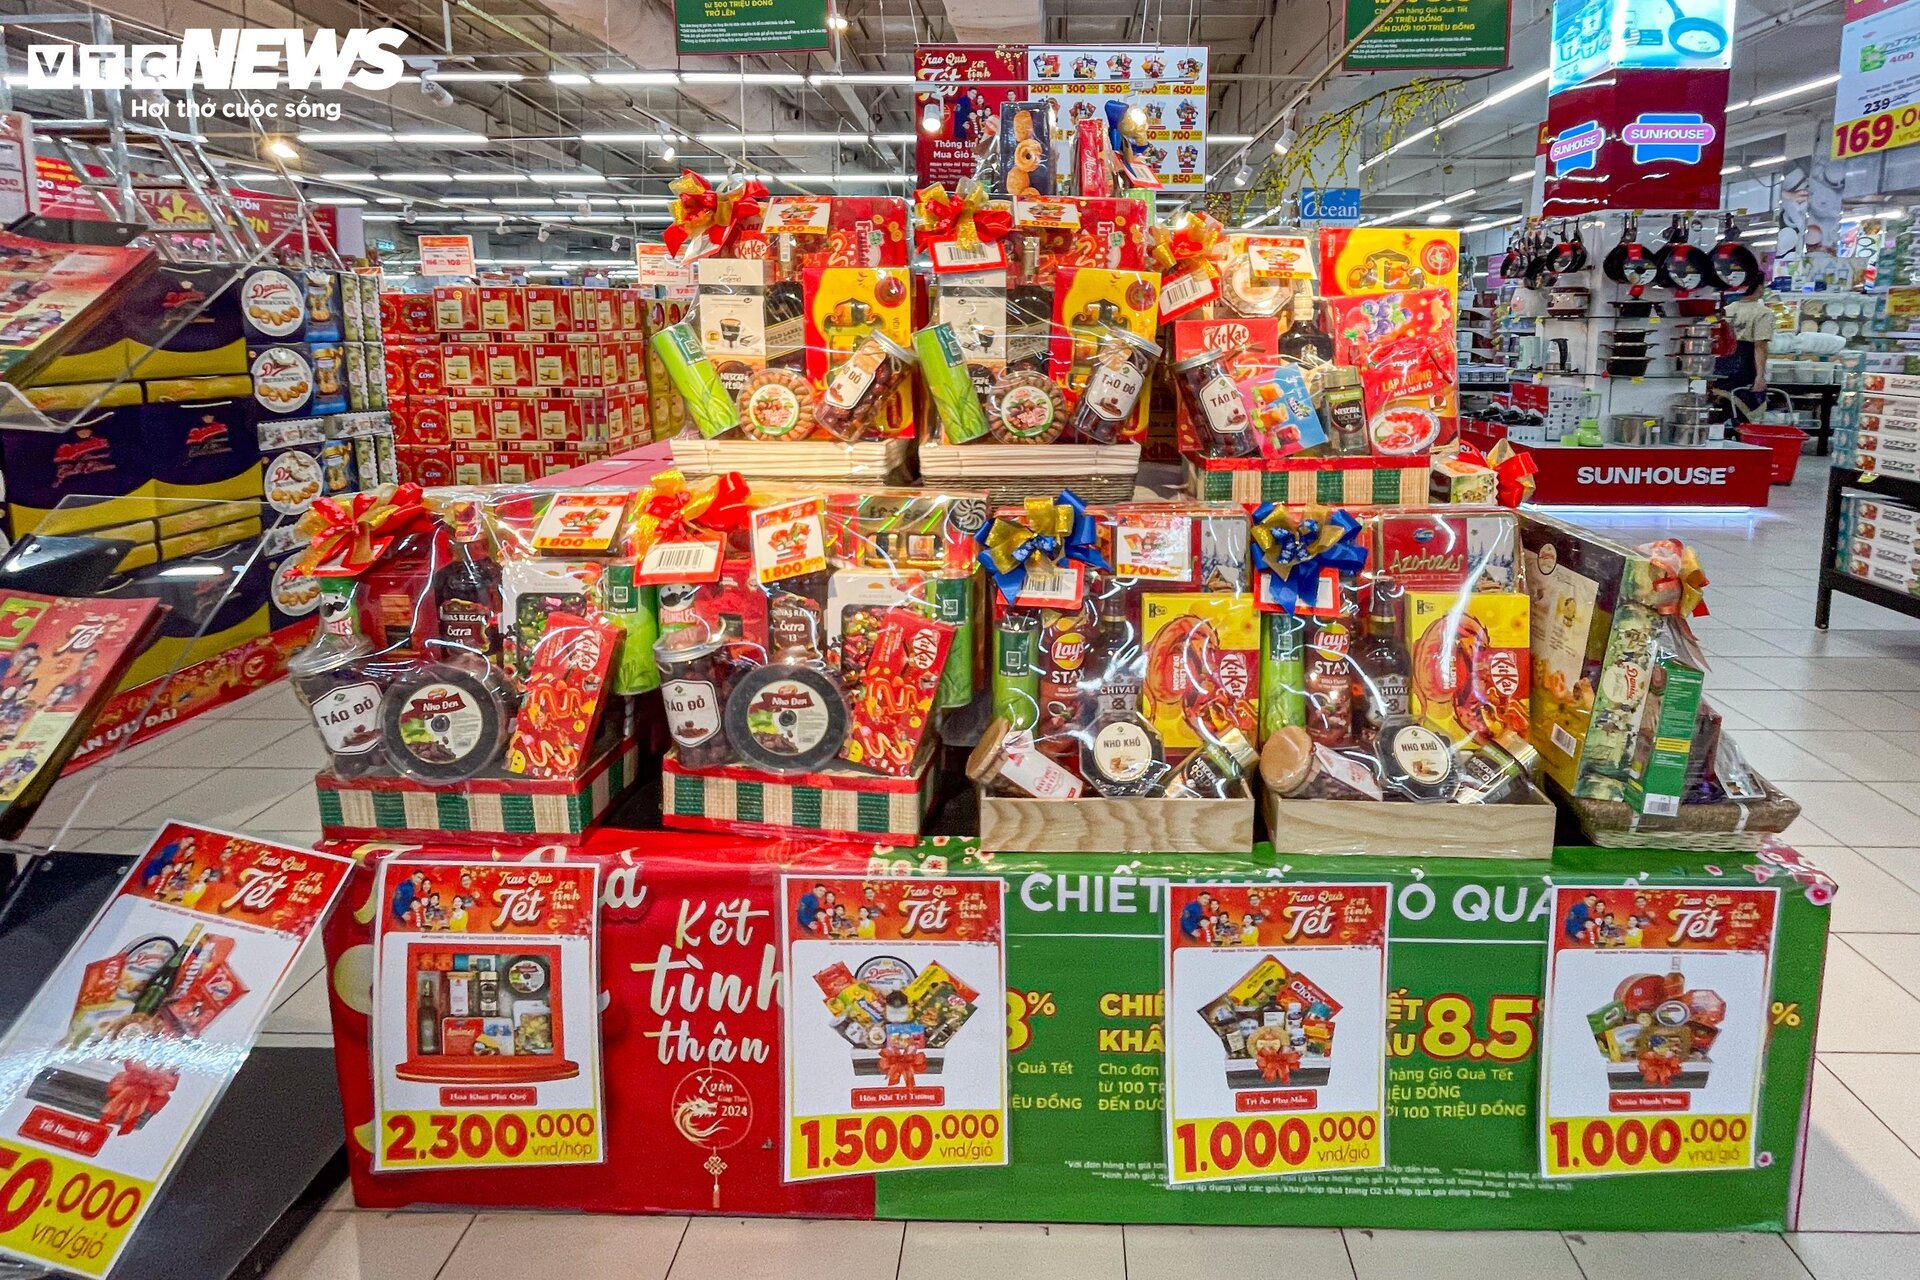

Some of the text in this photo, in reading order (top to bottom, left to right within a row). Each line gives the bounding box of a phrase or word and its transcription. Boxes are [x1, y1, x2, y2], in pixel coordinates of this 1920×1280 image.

[1630, 128, 1706, 140] SUNHOUSE
[1553, 135, 1598, 156] SUNHOUSE
[1303, 200, 1358, 217] Ocean
[1209, 325, 1247, 351] KitKat
[1577, 466, 1729, 486] SUNHOUSE
[914, 627, 939, 670] KitKat
[1221, 656, 1249, 697] KitKat
[1314, 661, 1350, 675] STAX
[1491, 653, 1519, 694] KitKat
[1100, 686, 1136, 695] CHIVAS
[1381, 686, 1408, 695] HIVAS
[321, 696, 375, 727] TÁO ĐỎ
[423, 699, 460, 712] Nho Đen
[1103, 739, 1121, 748] NHO
[1400, 743, 1419, 751] NHO
[219, 866, 288, 911] Tết
[499, 871, 554, 886] Trao Quà
[1020, 859, 1169, 913] CHIẾT
[903, 884, 959, 898] Trao Quà
[1287, 889, 1345, 905] Trao Quà
[491, 885, 546, 929] Tết
[898, 896, 952, 937] Tết
[676, 898, 770, 950] Kết
[1282, 903, 1337, 942] Tết
[1667, 906, 1724, 941] Tết
[630, 943, 785, 1017] tình
[1098, 988, 1166, 1018] CHIẾ
[1098, 1023, 1166, 1054] KHẤ
[1423, 997, 1545, 1060] 8.5
[643, 1019, 770, 1065] thân
[1017, 1060, 1074, 1077] Quà Tết
[1098, 1062, 1160, 1077] Cho đơn
[1457, 1063, 1486, 1081] Quà
[1490, 1061, 1515, 1081] Tết
[696, 1075, 734, 1096] Xuân
[1118, 1081, 1145, 1095] 100
[721, 1105, 749, 1118] 2024
[1035, 1093, 1083, 1111] ĐỒNG
[1098, 1093, 1131, 1112] ĐẾN
[386, 1113, 595, 1162] 2.300.000
[801, 1114, 1000, 1169] 1.500.000
[1177, 1116, 1377, 1173] 1.000.000
[1549, 1119, 1747, 1168] 1.000.000
[940, 1141, 993, 1159] vnd/giỏ
[1317, 1146, 1371, 1163] vnd/giỏ
[1687, 1145, 1740, 1165] vnd/giỏ
[33, 1218, 105, 1259] vnd/giỏ
